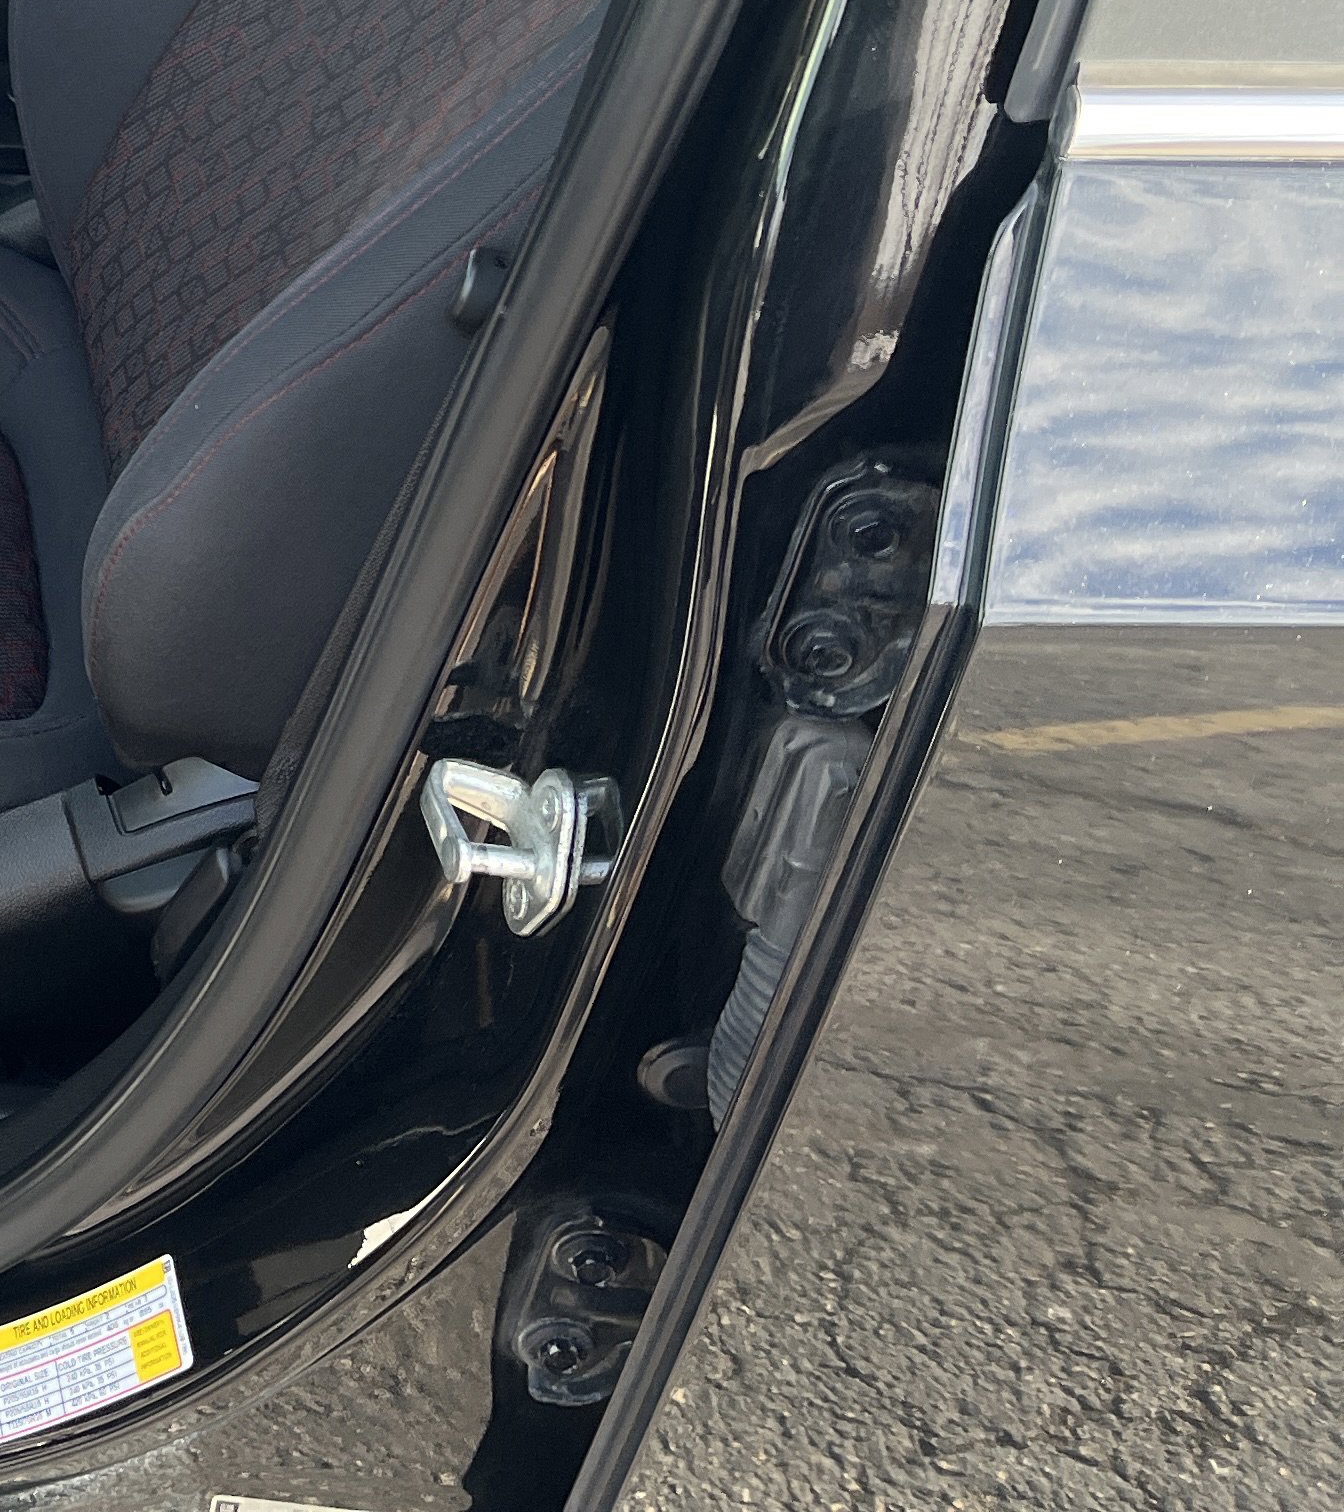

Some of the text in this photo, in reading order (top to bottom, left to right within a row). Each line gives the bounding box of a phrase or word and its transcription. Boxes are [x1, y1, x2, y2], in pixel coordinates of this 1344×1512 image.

[13, 1278, 137, 1339] TIRE AND LOADING INFORMATION
